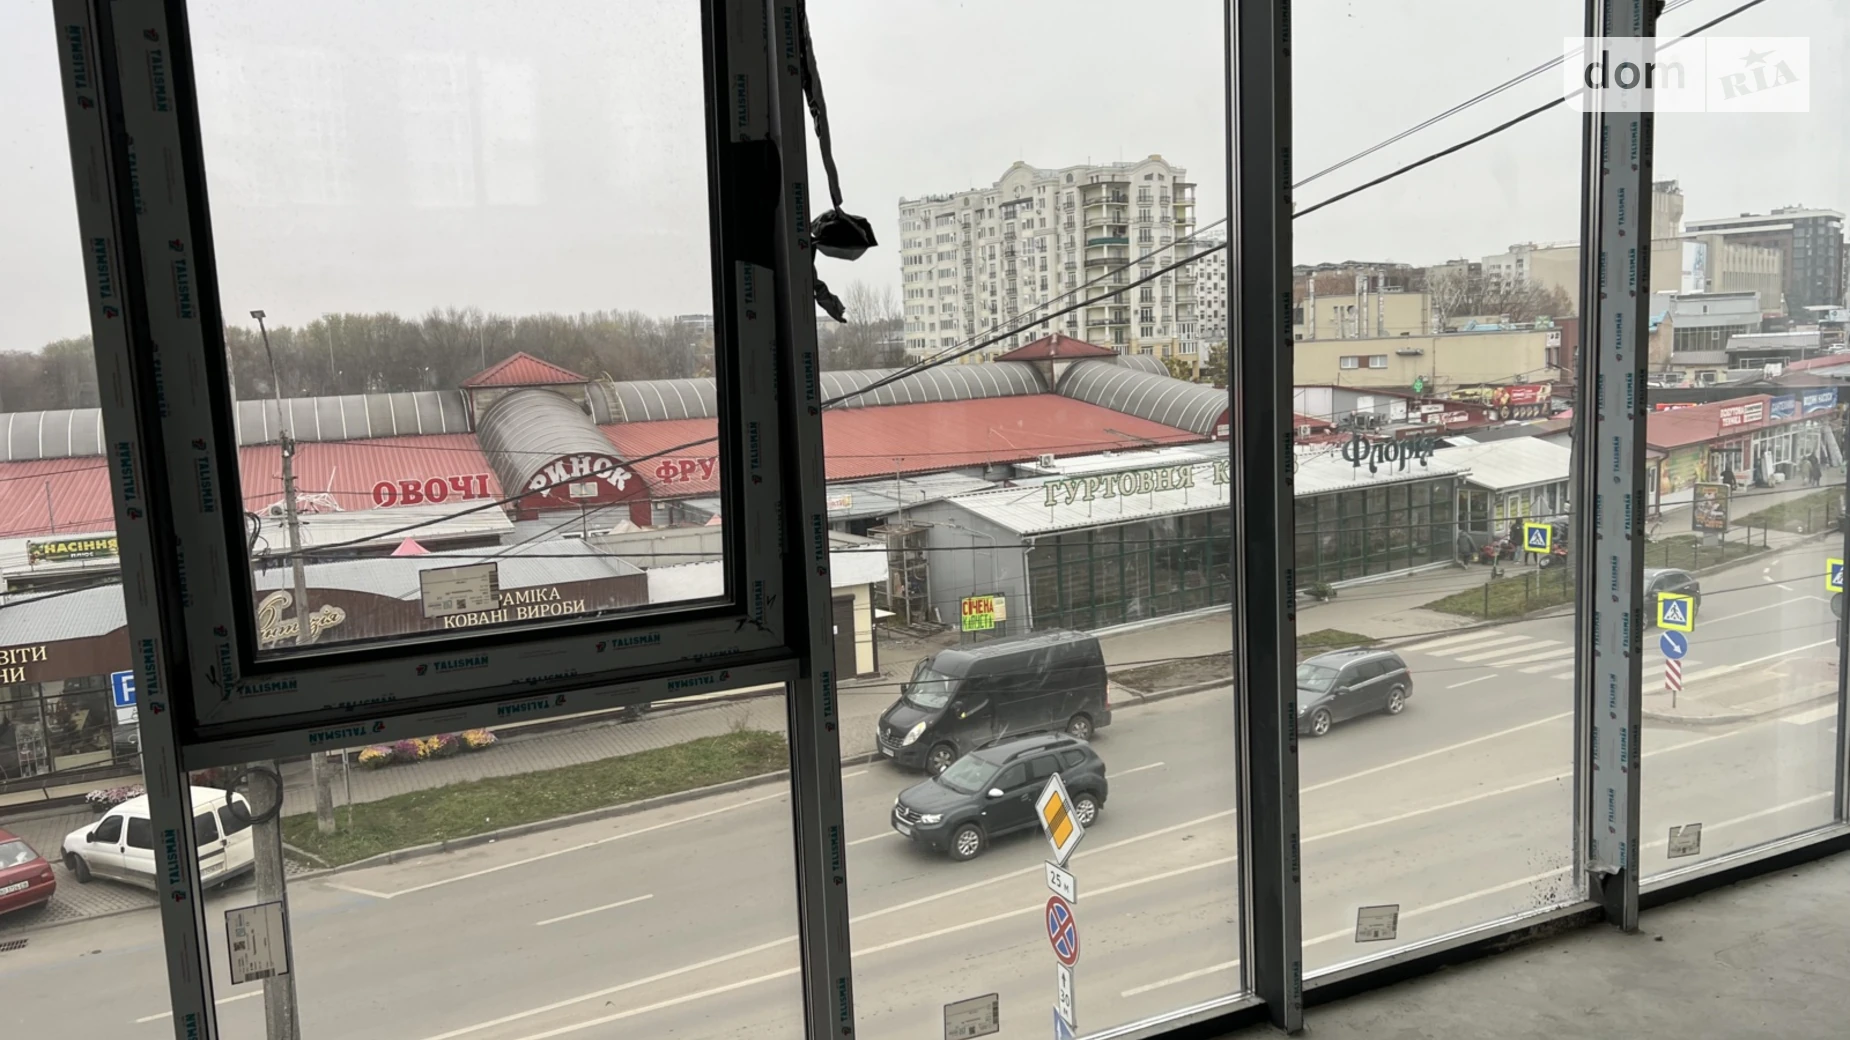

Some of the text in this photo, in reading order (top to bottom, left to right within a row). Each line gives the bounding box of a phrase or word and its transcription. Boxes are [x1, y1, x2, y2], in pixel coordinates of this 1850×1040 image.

[784, 7, 794, 59] TALISMAN
[69, 25, 87, 88] TALISMAN
[150, 50, 168, 112] TALISMAN
[737, 74, 747, 127] TALISMAN
[794, 182, 804, 233] TALISMAN
[94, 238, 112, 298] TALISMAN
[175, 259, 191, 319] TALISMAN
[804, 352, 814, 400] TALISMAN
[750, 422, 758, 469] TALISMAN
[119, 442, 136, 501] TALISMAN
[199, 457, 214, 513] TALISMAN
[372, 474, 490, 508] ОВОЧІ
[528, 455, 631, 497] РИНОК
[1044, 463, 1194, 507] ГУРТОВНЯ
[44, 539, 118, 554] НАСІННЯ
[813, 514, 823, 561] TALISMAN
[444, 600, 585, 629] КОВАНІ ВИРОБИ
[434, 656, 489, 671] TALISMAN
[612, 634, 661, 648] TALISMAN
[143, 639, 158, 696] TALISMAN
[667, 673, 714, 690] TALISMAN
[497, 700, 549, 716] TALISMAN
[822, 671, 833, 717] TALISMAN
[309, 727, 366, 743] TALISMAN
[165, 829, 181, 885] TALISMAN
[829, 825, 840, 871] TALISMAN
[1050, 871, 1062, 888] 25
[839, 977, 849, 1022] TALISMAN
